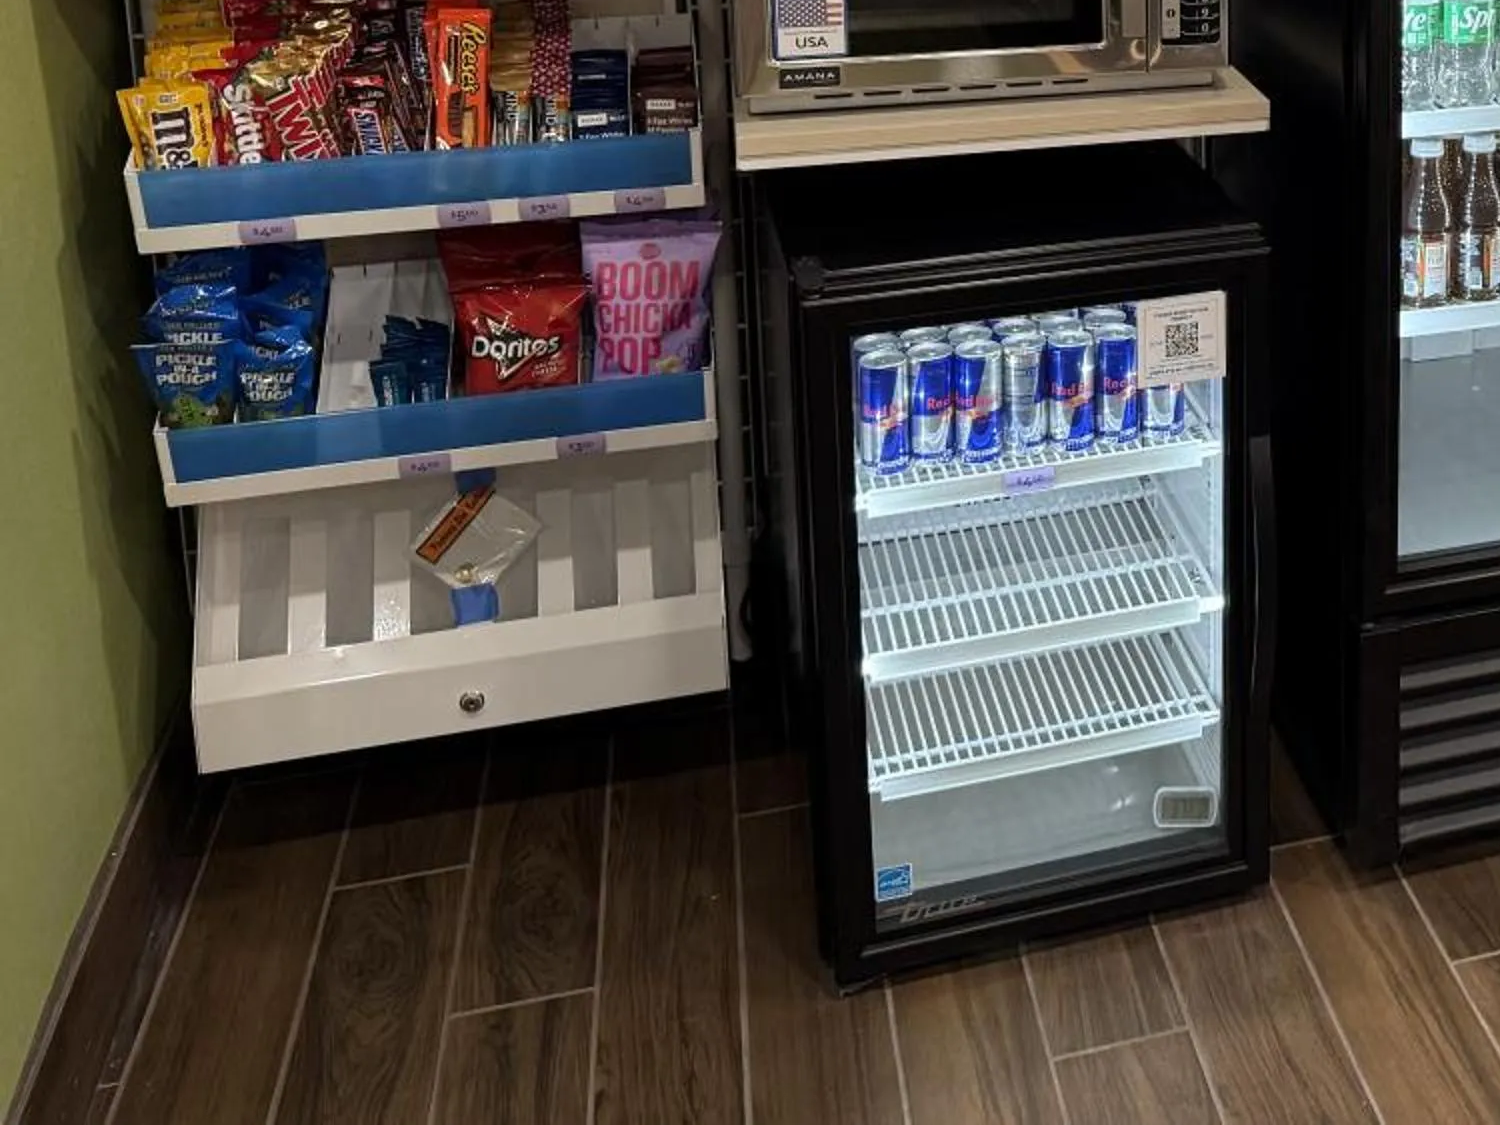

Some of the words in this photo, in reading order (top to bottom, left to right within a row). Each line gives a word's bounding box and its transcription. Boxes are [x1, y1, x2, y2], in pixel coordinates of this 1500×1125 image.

[1201, 8, 1208, 18] 9
[795, 36, 829, 49] USA
[460, 22, 488, 95] Reese's
[784, 72, 835, 82] AMANA
[223, 83, 264, 164] Skittle
[353, 110, 386, 155] SNICK
[596, 260, 699, 301] BOOM
[598, 301, 691, 334] CHICKA
[472, 335, 560, 359] Doritos
[599, 335, 662, 376] POP
[155, 353, 217, 368] PICKLE
[156, 371, 218, 387] POUCH
[928, 397, 951, 410] Red
